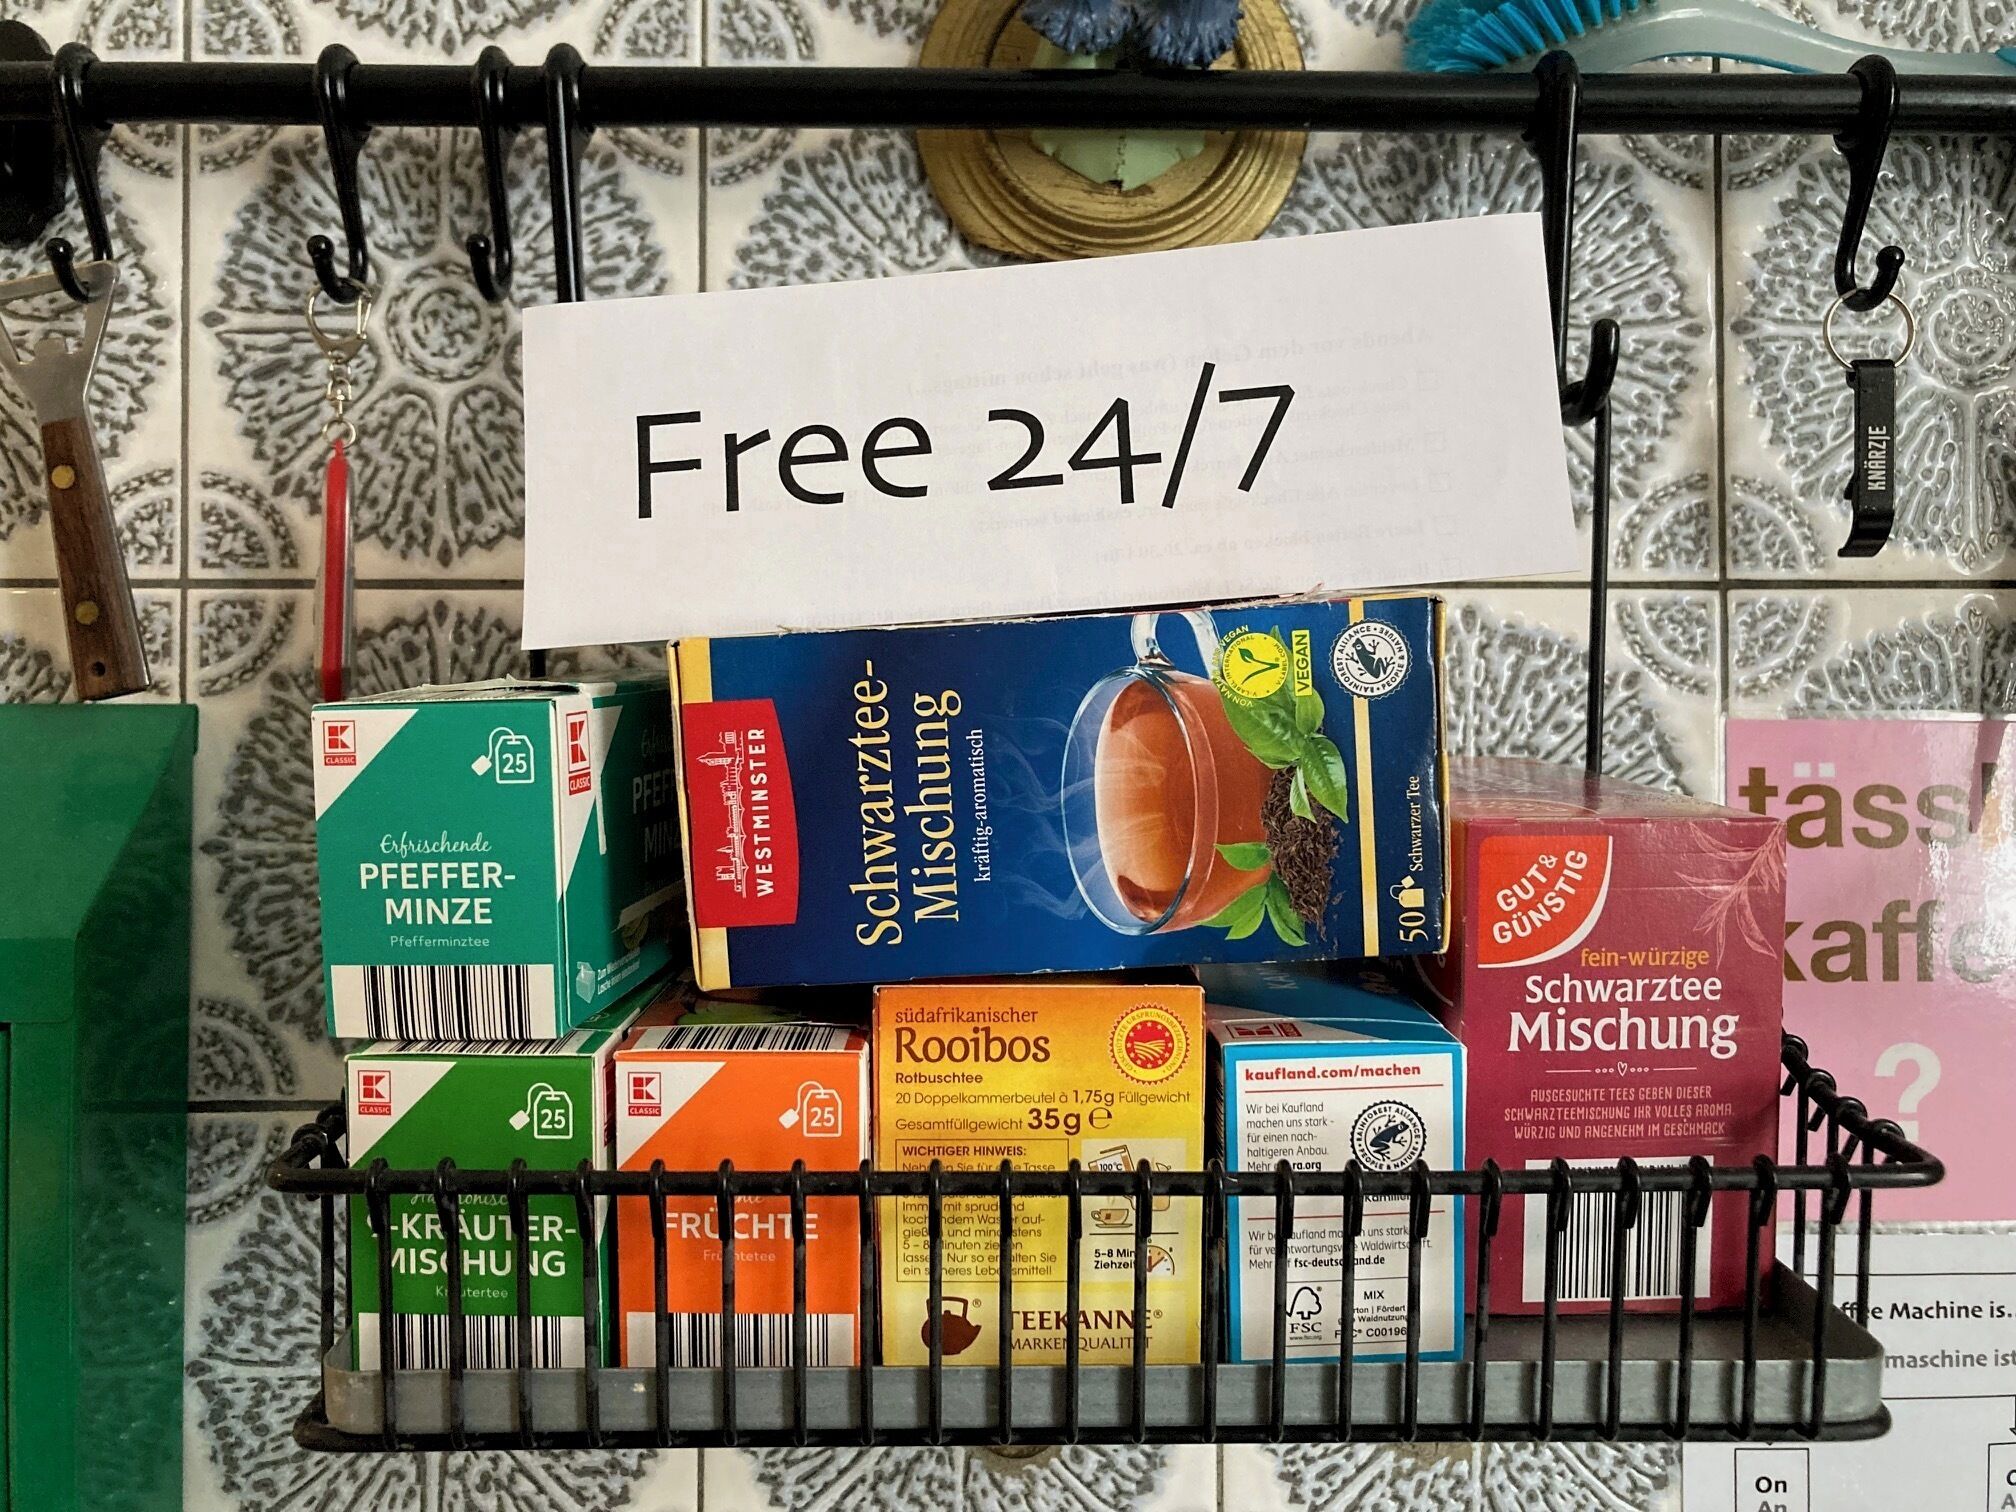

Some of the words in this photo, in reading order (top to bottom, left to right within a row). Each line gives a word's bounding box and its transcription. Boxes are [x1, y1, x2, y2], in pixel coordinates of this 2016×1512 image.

[635, 411, 932, 520] Free
[987, 361, 1295, 511] 24/7
[1864, 425, 1891, 491] KNÄRZJE
[1220, 625, 1249, 647] VEGAN
[1338, 626, 1371, 654] ALLIANCE
[1379, 627, 1404, 653] NATURE
[1295, 633, 1310, 692] VEGAN
[1337, 657, 1374, 693] RAINFOREST
[1382, 664, 1405, 690] PEOPLE
[325, 757, 356, 765] CLASSIC
[502, 753, 527, 774] 25
[569, 776, 591, 792] CLASSIC
[1407, 775, 1420, 797] Tee
[848, 659, 903, 946] Schwarztee-
[903, 689, 963, 923] Mischung
[965, 728, 992, 883] kräftig-aromatisch
[748, 728, 774, 898] WESTMINSTER
[380, 830, 492, 858] Erfrischende
[1409, 800, 1424, 872] Schwarzer
[360, 862, 516, 890] PFEFFER-
[1492, 850, 1588, 944] GÜNSTIG
[385, 897, 493, 925] MINZE
[1399, 912, 1428, 942] 50
[390, 935, 490, 947] Pfefferminztee
[1580, 947, 1710, 970] fein-würzige
[1525, 973, 1722, 1004] Schwarztee
[895, 1007, 1038, 1023] südafrikanischer
[1507, 1007, 1739, 1060] Mischung
[895, 1026, 1051, 1064] Rooibos
[895, 1072, 983, 1084] Rotbuschtee
[1245, 1064, 1421, 1081] kaufland.com/machen
[895, 1093, 911, 1104] 20
[914, 1091, 1055, 1108] Doppelkammerbeutel
[1059, 1091, 1068, 1104] à
[1073, 1090, 1114, 1108] 1,75g
[1118, 1091, 1190, 1107] Füllgewicht
[1530, 1088, 1605, 1103] AUSGESUCHTE
[1609, 1088, 1635, 1101] TEES
[1639, 1087, 1672, 1100] GEBEN
[1676, 1085, 1712, 1100] DIESER
[1874, 1042, 1941, 1142] ?
[360, 1106, 390, 1114] CLASSIC
[630, 1107, 660, 1115] CLASSIC
[810, 1107, 835, 1127] 25
[1246, 1104, 1262, 1114] Wir
[1266, 1103, 1279, 1113] bei
[1282, 1102, 1324, 1113] Kaufland
[1504, 1106, 1630, 1121] SCHWARZTEEMISCHUNG
[1634, 1105, 1651, 1118] IHR
[1655, 1104, 1692, 1118] VOLLES
[541, 1109, 566, 1129] 25
[895, 1117, 1023, 1134] Gesamtfüllgewicht
[1027, 1107, 1081, 1136] 35g
[1246, 1119, 1284, 1129] machen
[1305, 1117, 1328, 1127] stark
[1357, 1106, 1392, 1141] RAINFOREST
[1395, 1107, 1420, 1139] ALLIANCE
[1247, 1132, 1260, 1143] für
[1263, 1132, 1288, 1141] einen
[1290, 1130, 1317, 1141] nach-
[1514, 1122, 1556, 1140] WÜRZIG
[1559, 1125, 1581, 1138] UND
[1584, 1124, 1644, 1138] ANGENEHM
[1648, 1123, 1660, 1137] IM
[1664, 1121, 1725, 1136] GESCHMACK
[903, 1146, 969, 1156] WICHTIGER
[974, 1146, 1026, 1156] HINWEIS:
[1247, 1145, 1294, 1159] haltigeren
[1360, 1148, 1384, 1170] PEOPLE
[1394, 1146, 1419, 1169] NATURE
[943, 1202, 961, 1211] mit
[1022, 1214, 1045, 1224] auf-
[947, 1227, 970, 1237] und
[1249, 1231, 1265, 1241] Wir
[1292, 1228, 1326, 1239] aufland
[1368, 1228, 1383, 1237] uns
[903, 1240, 910, 1250] 5
[942, 1240, 978, 1250] inuten
[1250, 1245, 1263, 1254] für
[947, 1253, 967, 1263] Nur
[1041, 1253, 1057, 1263] Sie
[1250, 1259, 1272, 1269] Mehr
[903, 1266, 921, 1275] ein
[1364, 1290, 1384, 1300] MIX
[1890, 1301, 1983, 1319] Machine
[1290, 1322, 1322, 1333] FSC
[1755, 1476, 1787, 1493] On
